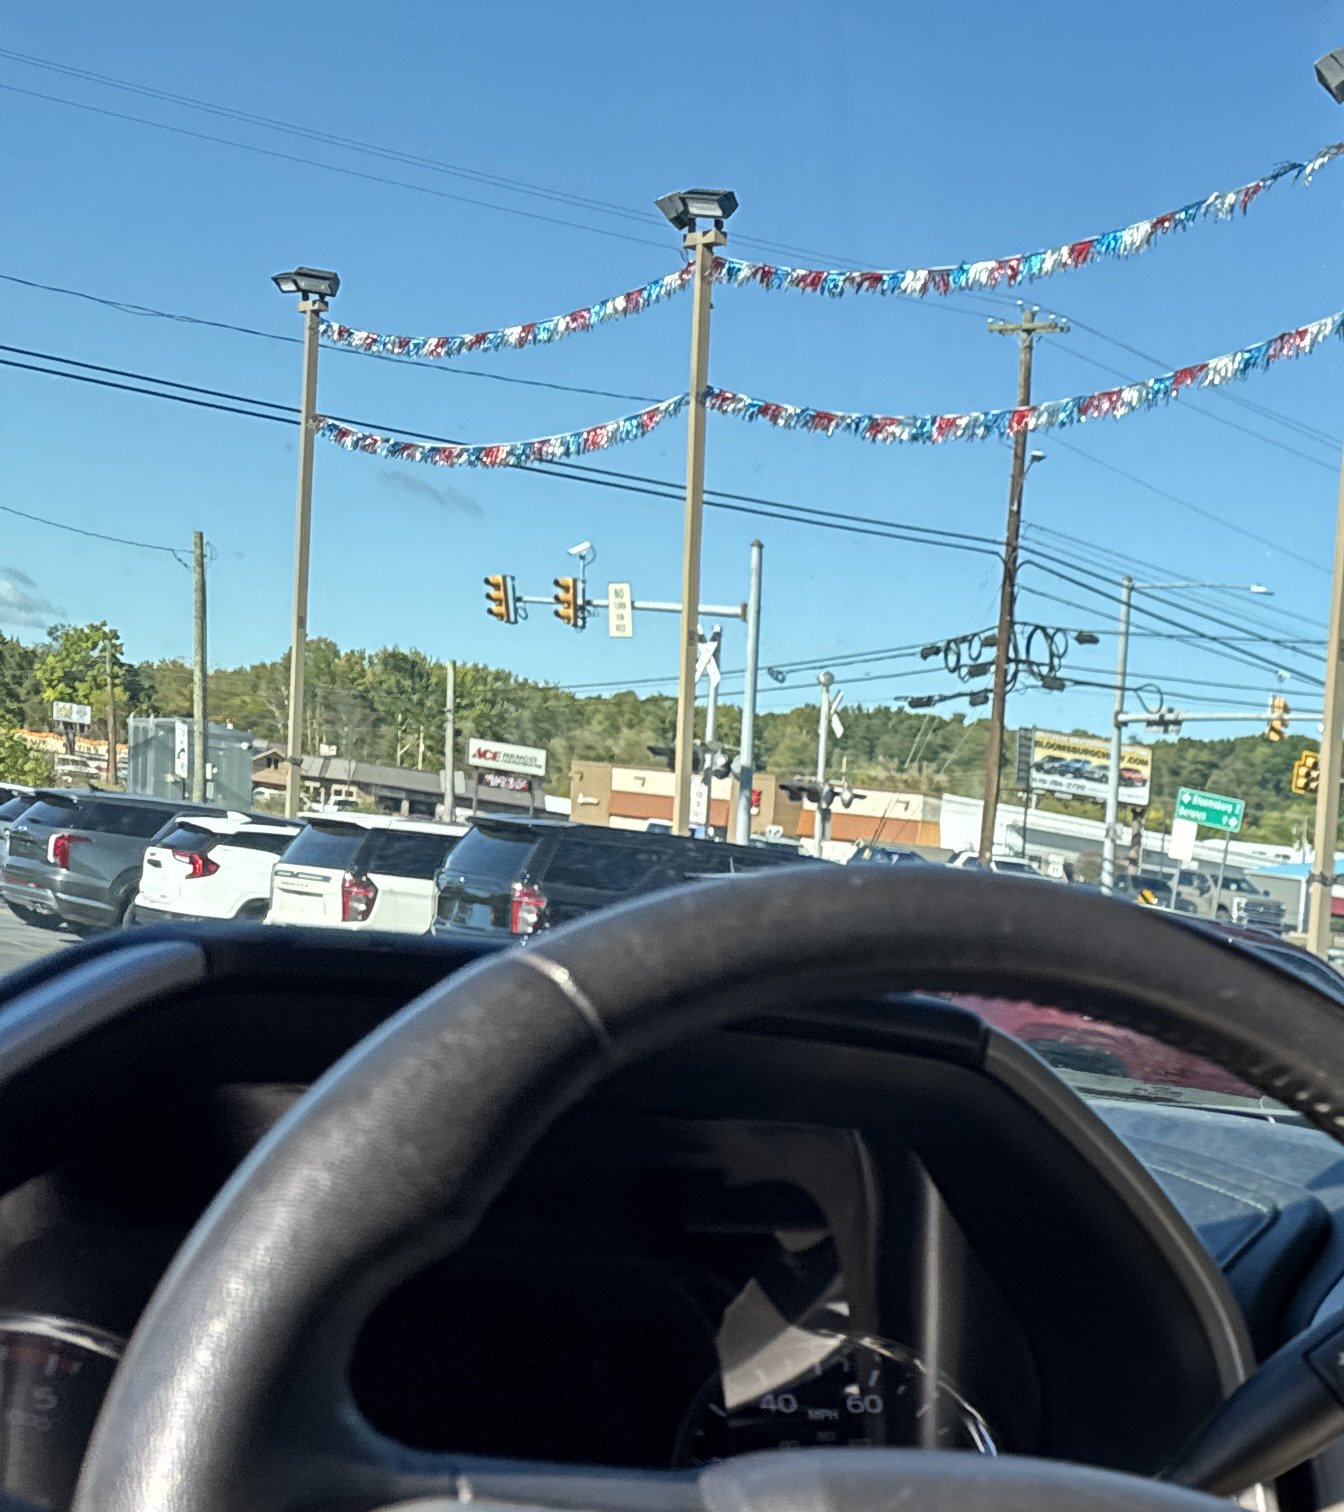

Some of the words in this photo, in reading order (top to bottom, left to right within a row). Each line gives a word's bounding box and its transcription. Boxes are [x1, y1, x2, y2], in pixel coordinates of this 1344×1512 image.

[614, 587, 625, 600] NO
[471, 747, 501, 763] ACE
[1191, 794, 1233, 814] Bloomsburg
[759, 1393, 799, 1414] 40
[845, 1393, 884, 1414] 60
